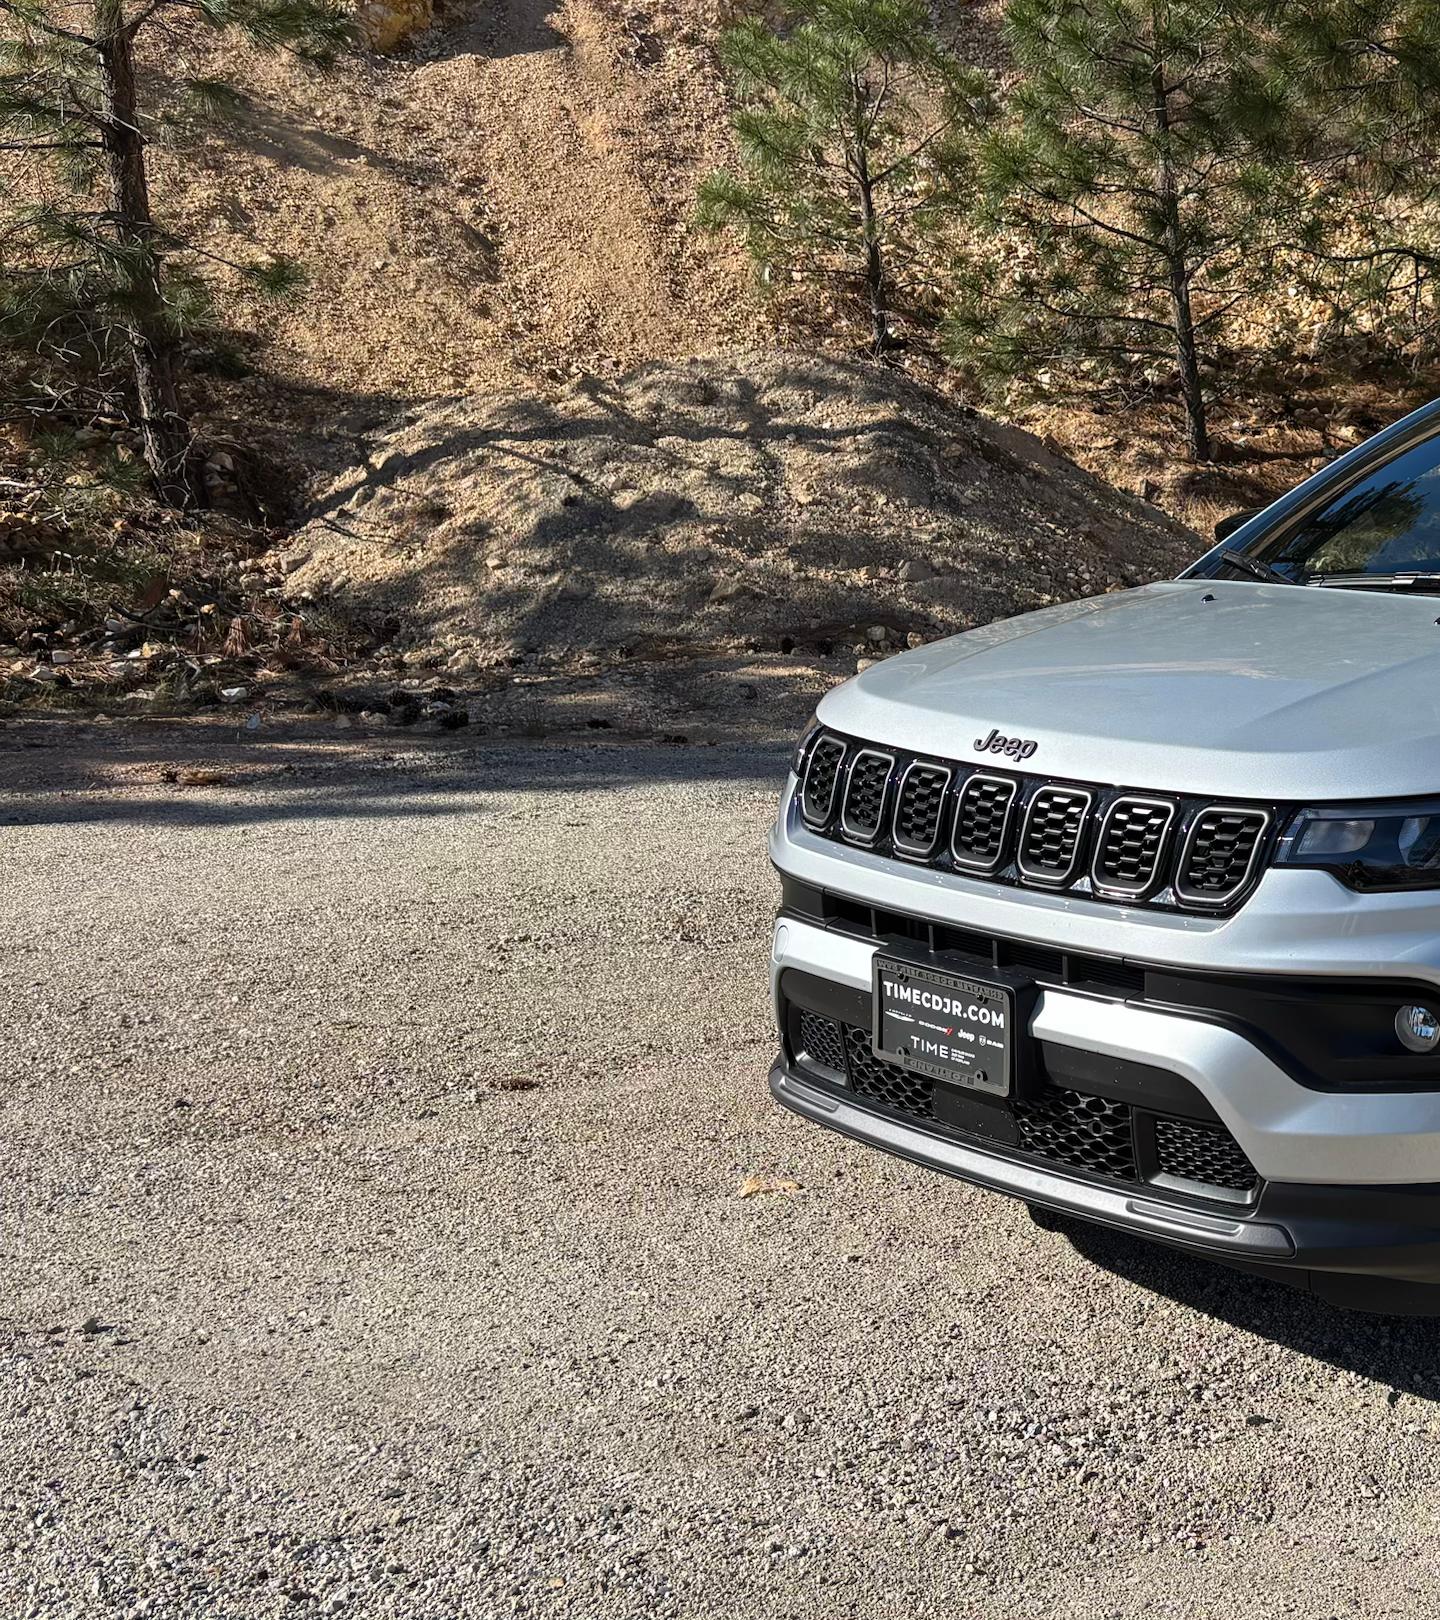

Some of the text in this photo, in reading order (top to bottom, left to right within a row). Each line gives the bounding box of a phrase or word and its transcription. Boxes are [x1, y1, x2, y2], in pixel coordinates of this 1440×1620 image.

[973, 729, 1038, 763] Jeep
[883, 981, 1005, 1029] TIMECDJR.COM
[910, 1035, 949, 1059] TIME
